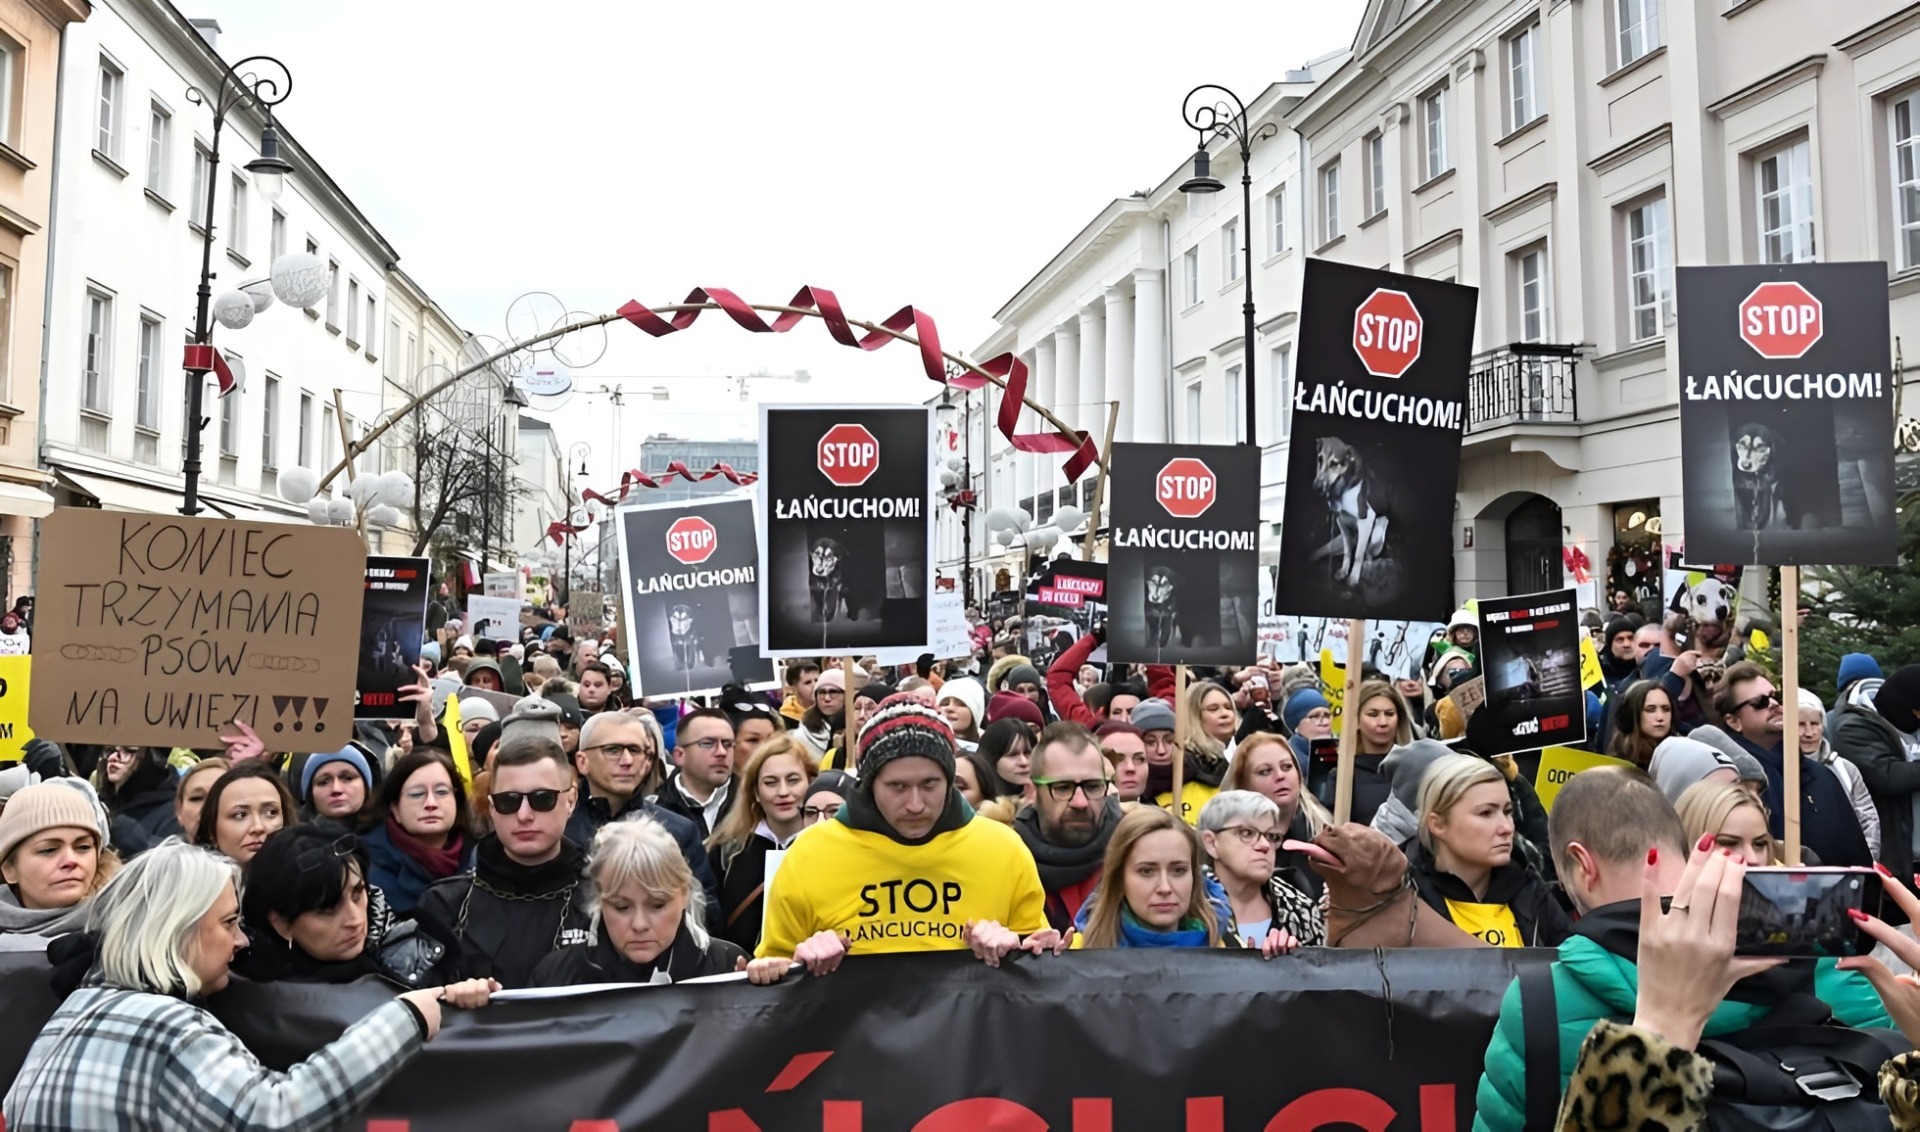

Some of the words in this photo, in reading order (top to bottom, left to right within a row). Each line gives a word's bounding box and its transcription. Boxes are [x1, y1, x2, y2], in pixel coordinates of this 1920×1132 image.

[1359, 312, 1418, 354] STOP
[1747, 304, 1816, 336] STOP
[1685, 369, 1883, 401] ŁAŃCUCHOM!
[1294, 379, 1462, 430] ŁAŃCUCHOM!
[822, 442, 874, 468] STOP
[1160, 475, 1212, 500] STOP
[775, 493, 920, 519] ŁAŃCUCHOM!
[118, 517, 293, 579] KONIEC
[670, 529, 714, 552] STOP
[1114, 524, 1255, 550] ŁAŃCUCHOM!
[63, 580, 320, 637] TRZYMANIA
[140, 629, 247, 676] PSÓW
[66, 687, 119, 727] NA
[858, 878, 962, 917] STOP
